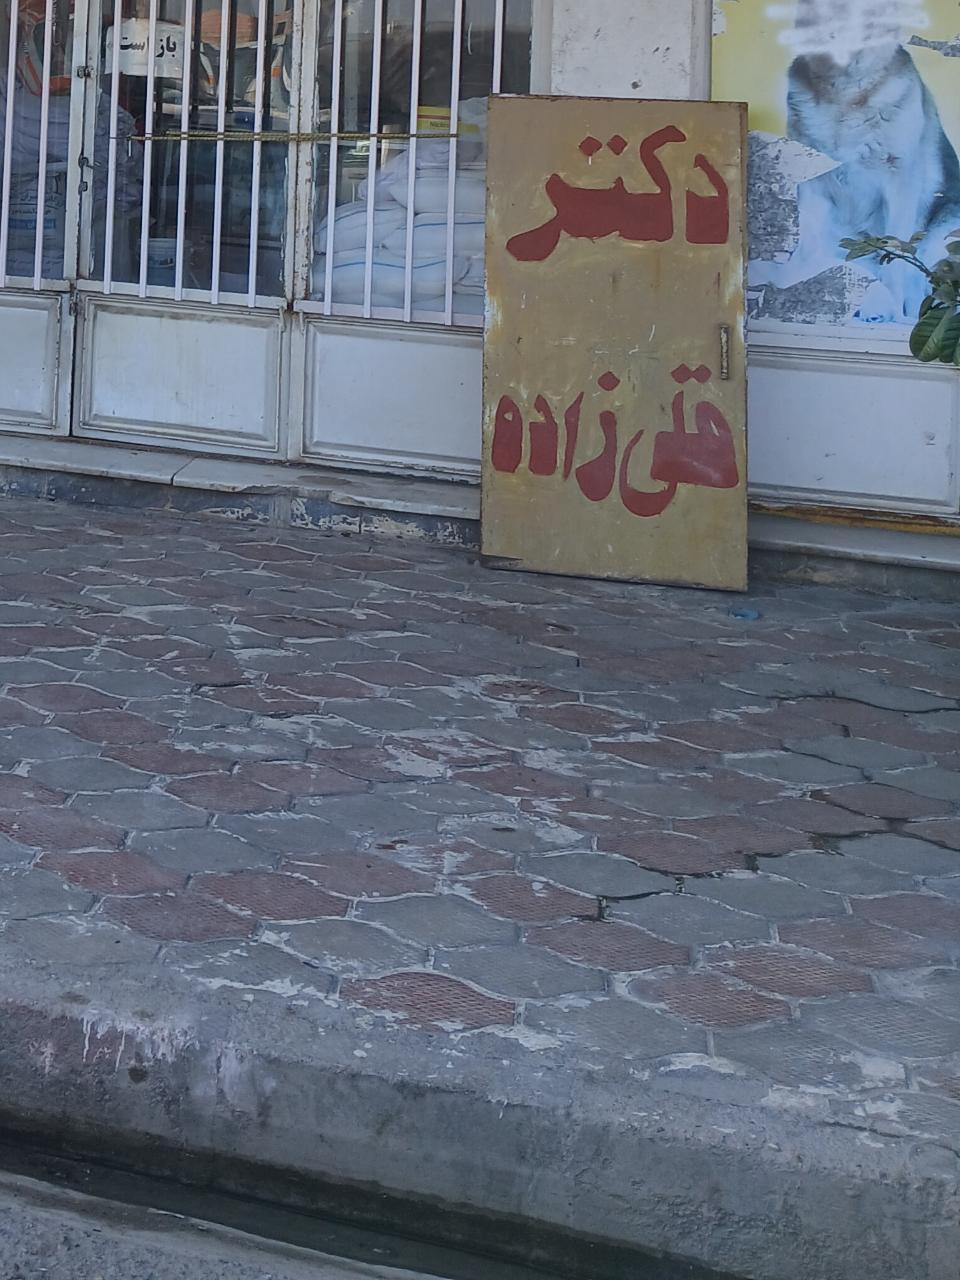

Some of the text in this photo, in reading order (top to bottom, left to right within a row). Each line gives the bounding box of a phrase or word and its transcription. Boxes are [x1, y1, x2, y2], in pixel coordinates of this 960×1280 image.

[154, 35, 177, 58] باز
[505, 124, 730, 262] دکتر
[491, 363, 741, 518] قلی زاده
